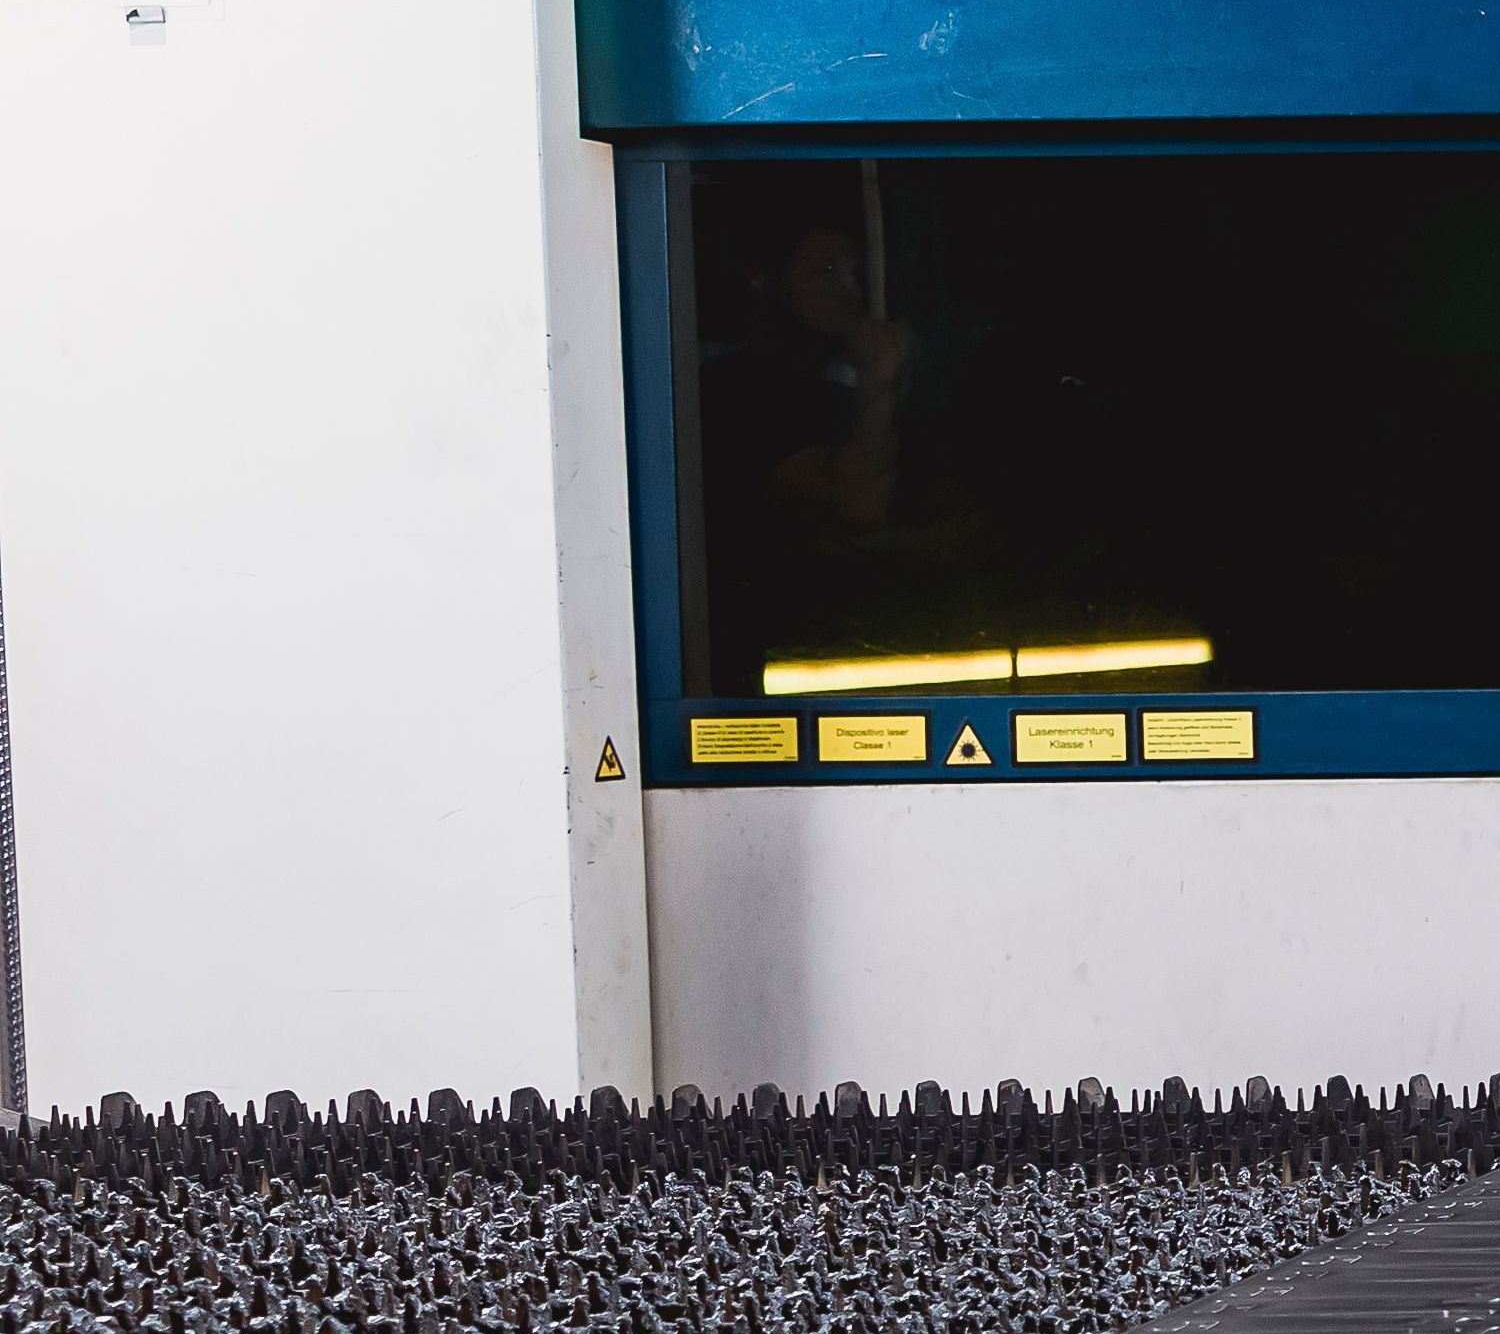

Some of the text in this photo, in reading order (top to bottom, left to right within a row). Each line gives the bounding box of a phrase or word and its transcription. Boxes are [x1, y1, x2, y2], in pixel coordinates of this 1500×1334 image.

[1028, 727, 1115, 737] Lasereinrichtung
[1049, 740, 1093, 749] Klasse 1
